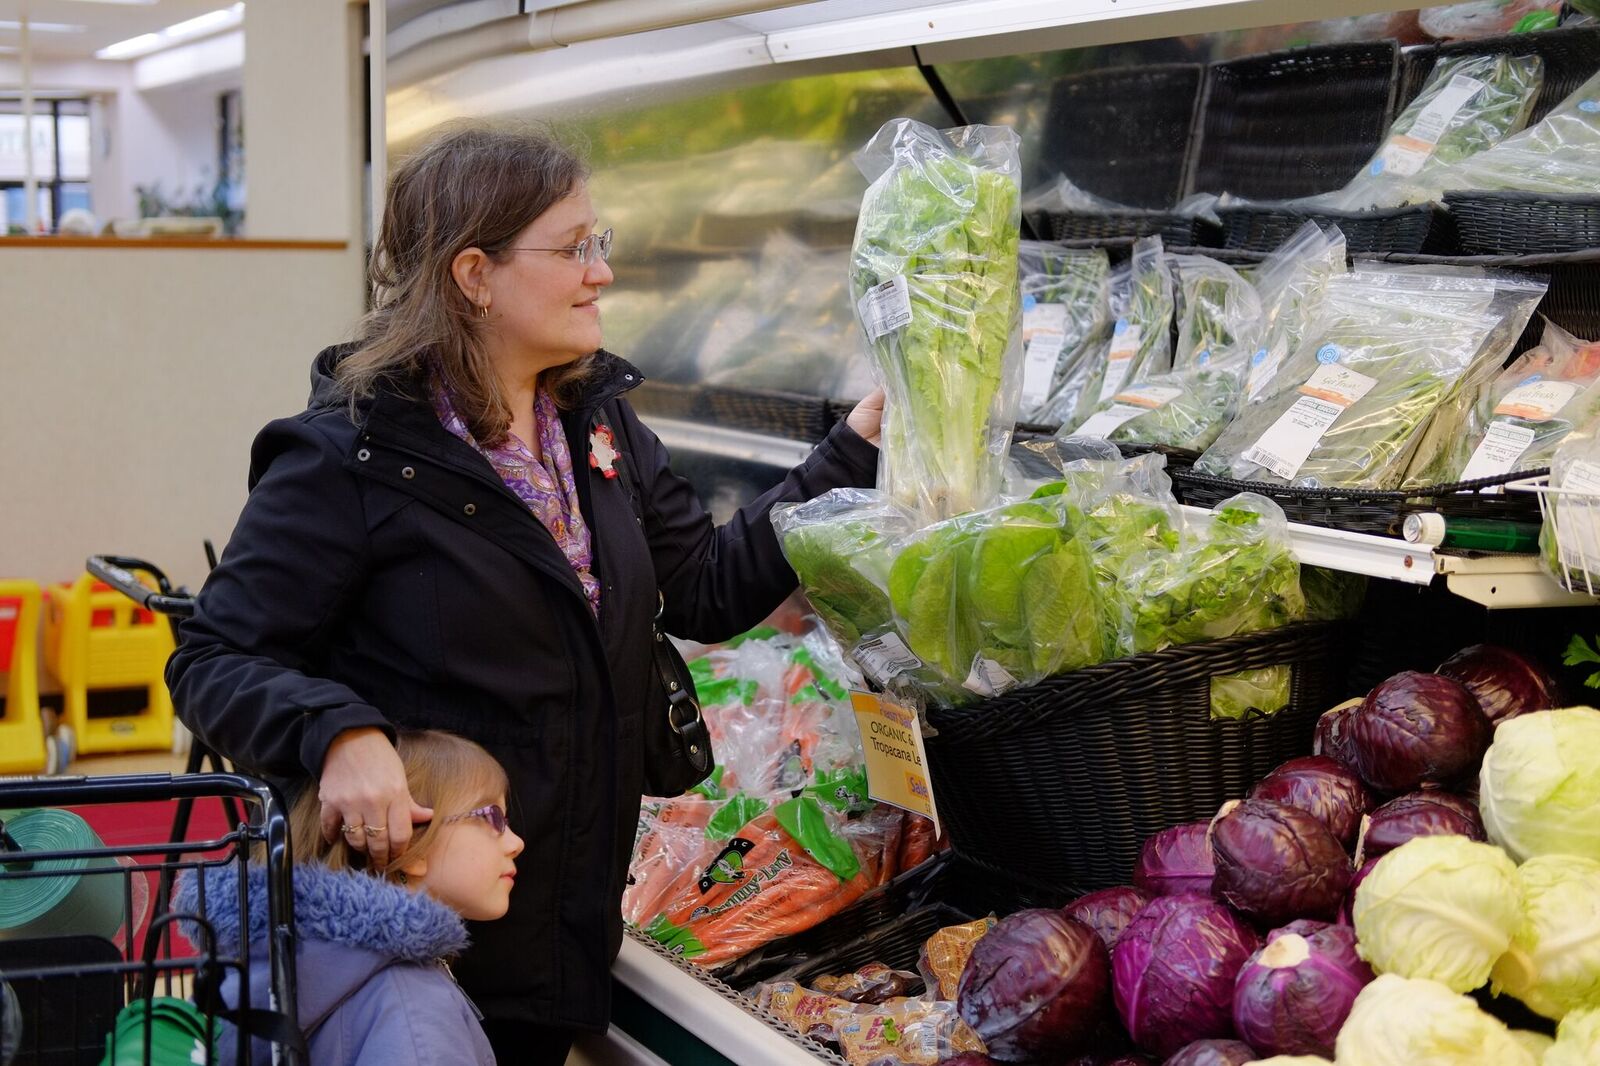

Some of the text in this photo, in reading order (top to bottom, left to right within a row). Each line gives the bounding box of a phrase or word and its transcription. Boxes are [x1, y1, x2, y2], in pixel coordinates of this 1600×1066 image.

[870, 721, 915, 746] ORGANIC &
[870, 736, 911, 761] Tropacana
